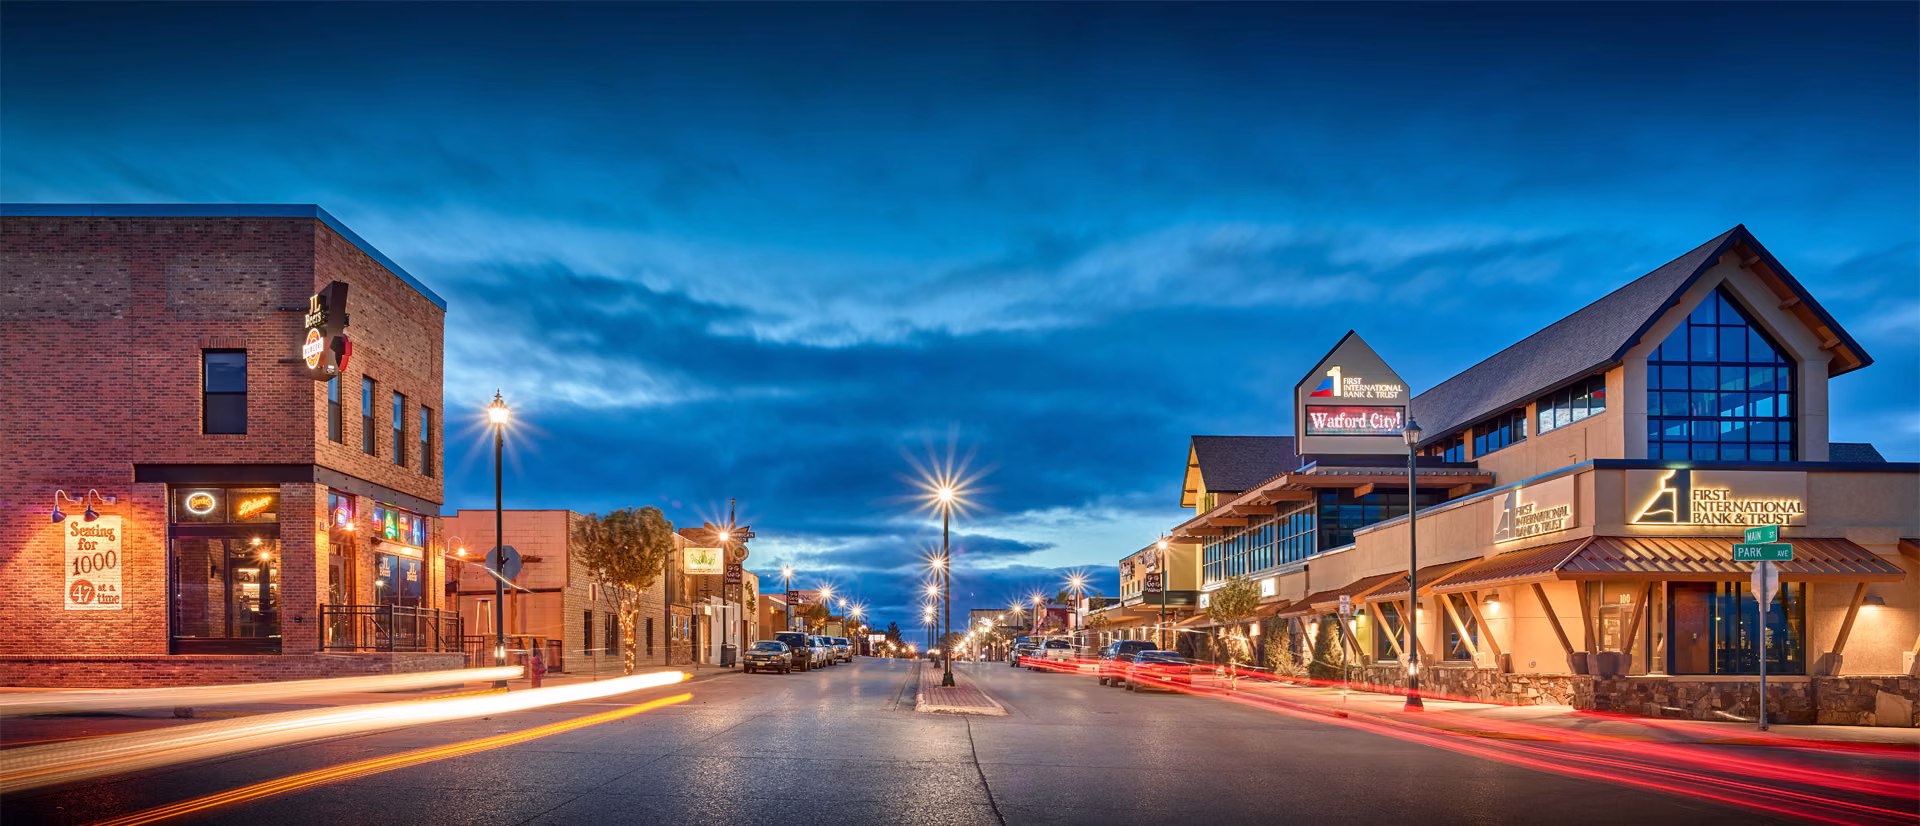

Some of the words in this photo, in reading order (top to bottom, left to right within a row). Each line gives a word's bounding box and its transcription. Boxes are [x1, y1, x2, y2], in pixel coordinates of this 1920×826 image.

[309, 294, 321, 315] JL
[305, 311, 322, 328] Beers
[1343, 377, 1362, 385] FIRST
[1343, 384, 1403, 392] INTERNATIONAL
[1375, 391, 1399, 399] TRUST
[1310, 412, 1366, 429] Watford
[1369, 411, 1401, 432] City!
[1692, 489, 1730, 501] FIRST
[1515, 503, 1534, 517] FIRST
[1692, 501, 1805, 513] INTERNATIONAL
[1515, 505, 1569, 527] INTERNATIONAL
[1692, 512, 1732, 524] BANK
[1734, 512, 1746, 524] &
[1750, 513, 1793, 525] TRUST
[70, 521, 115, 541] Seating
[1515, 525, 1534, 538] BANK
[1541, 518, 1563, 532] TRUST
[1747, 530, 1762, 542] MAIN
[1769, 531, 1775, 539] ST
[77, 538, 98, 550] for
[1737, 547, 1762, 558] PARK
[73, 550, 116, 576] 1000
[72, 584, 93, 603] 47
[97, 583, 107, 592] at
[108, 584, 116, 592] a
[97, 593, 120, 604] time
[1620, 593, 1631, 604] 100
